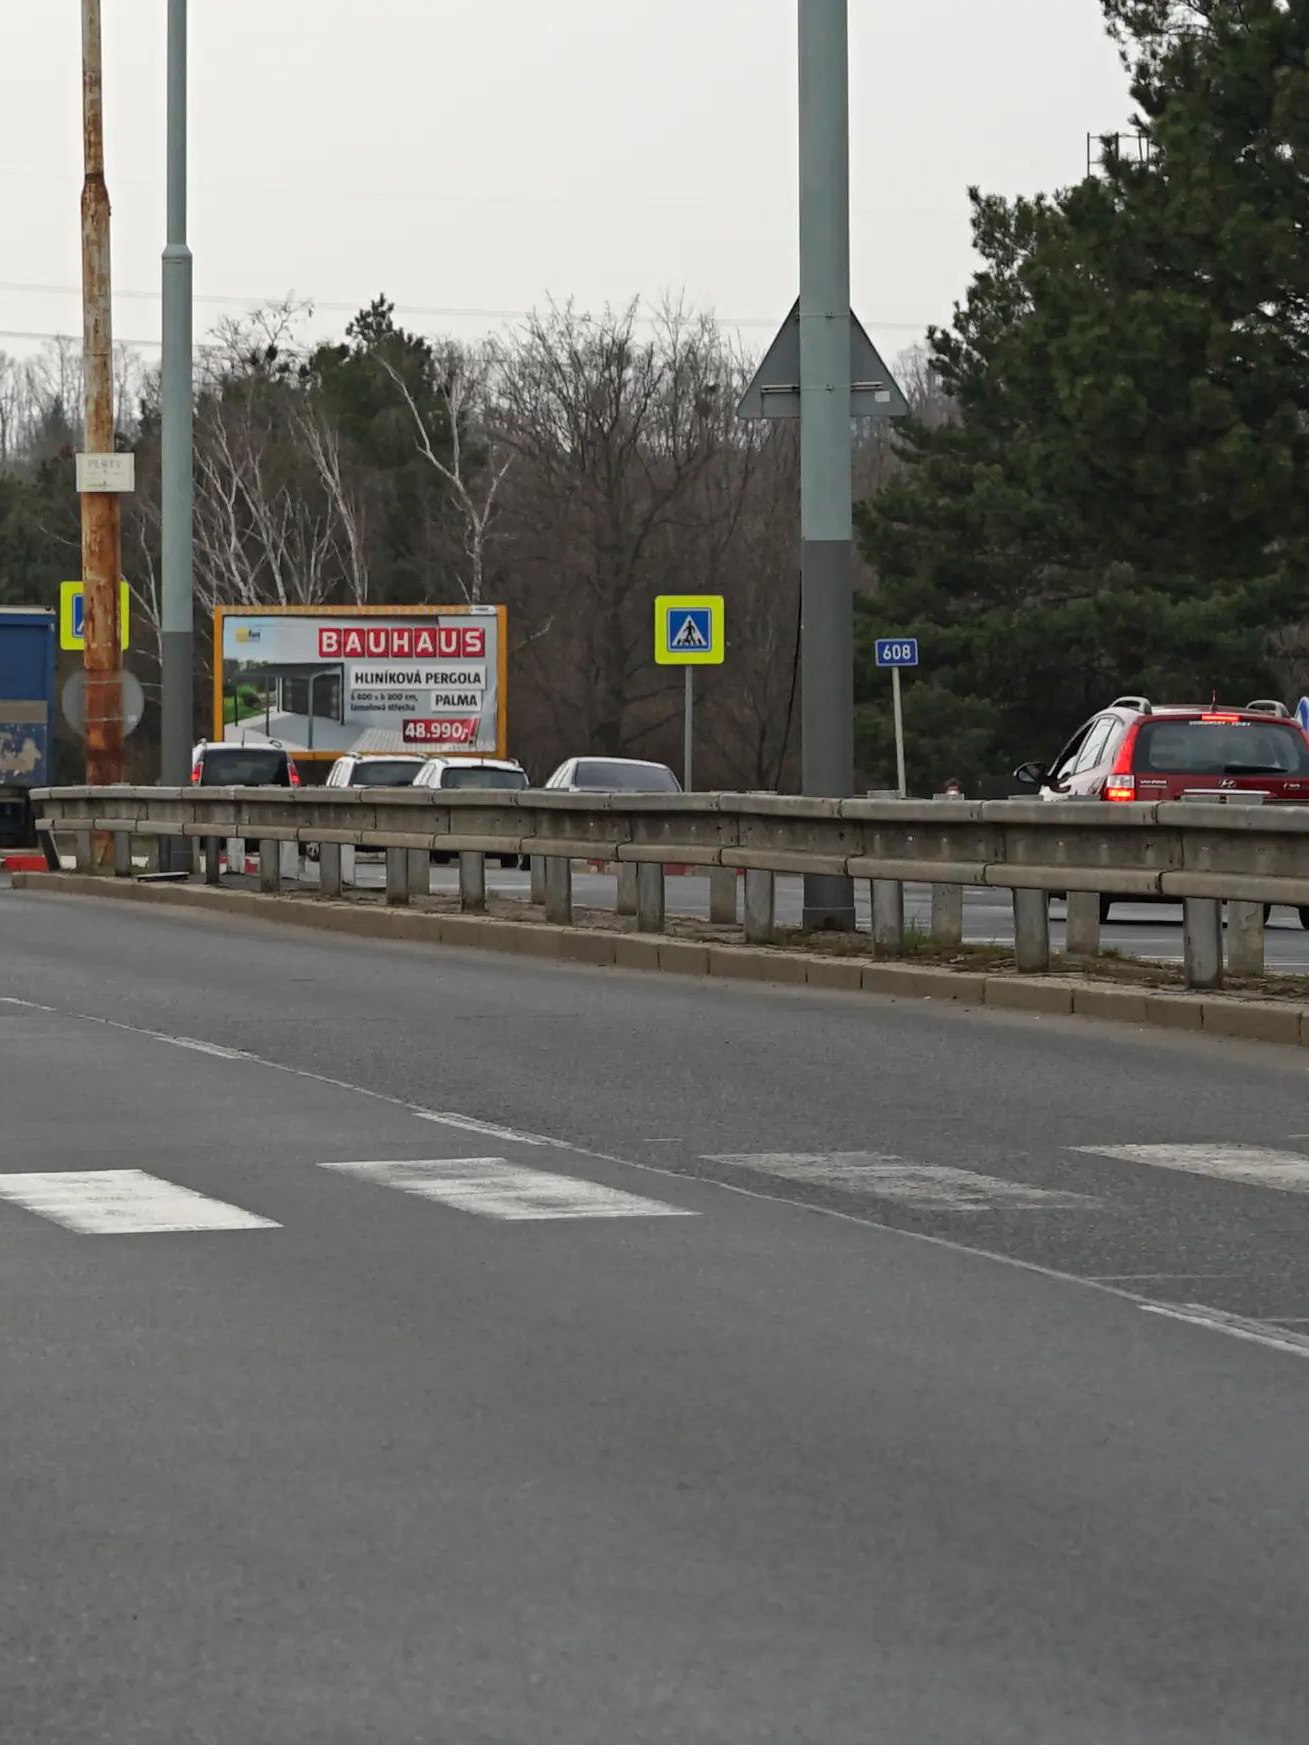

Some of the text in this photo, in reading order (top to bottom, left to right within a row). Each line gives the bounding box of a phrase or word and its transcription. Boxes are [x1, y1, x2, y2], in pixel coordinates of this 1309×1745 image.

[322, 631, 482, 653] BAUHAUS
[882, 644, 912, 660] 608
[354, 669, 482, 684] HLINÍKOVÁ PERGOLA
[435, 694, 478, 706] PALMA
